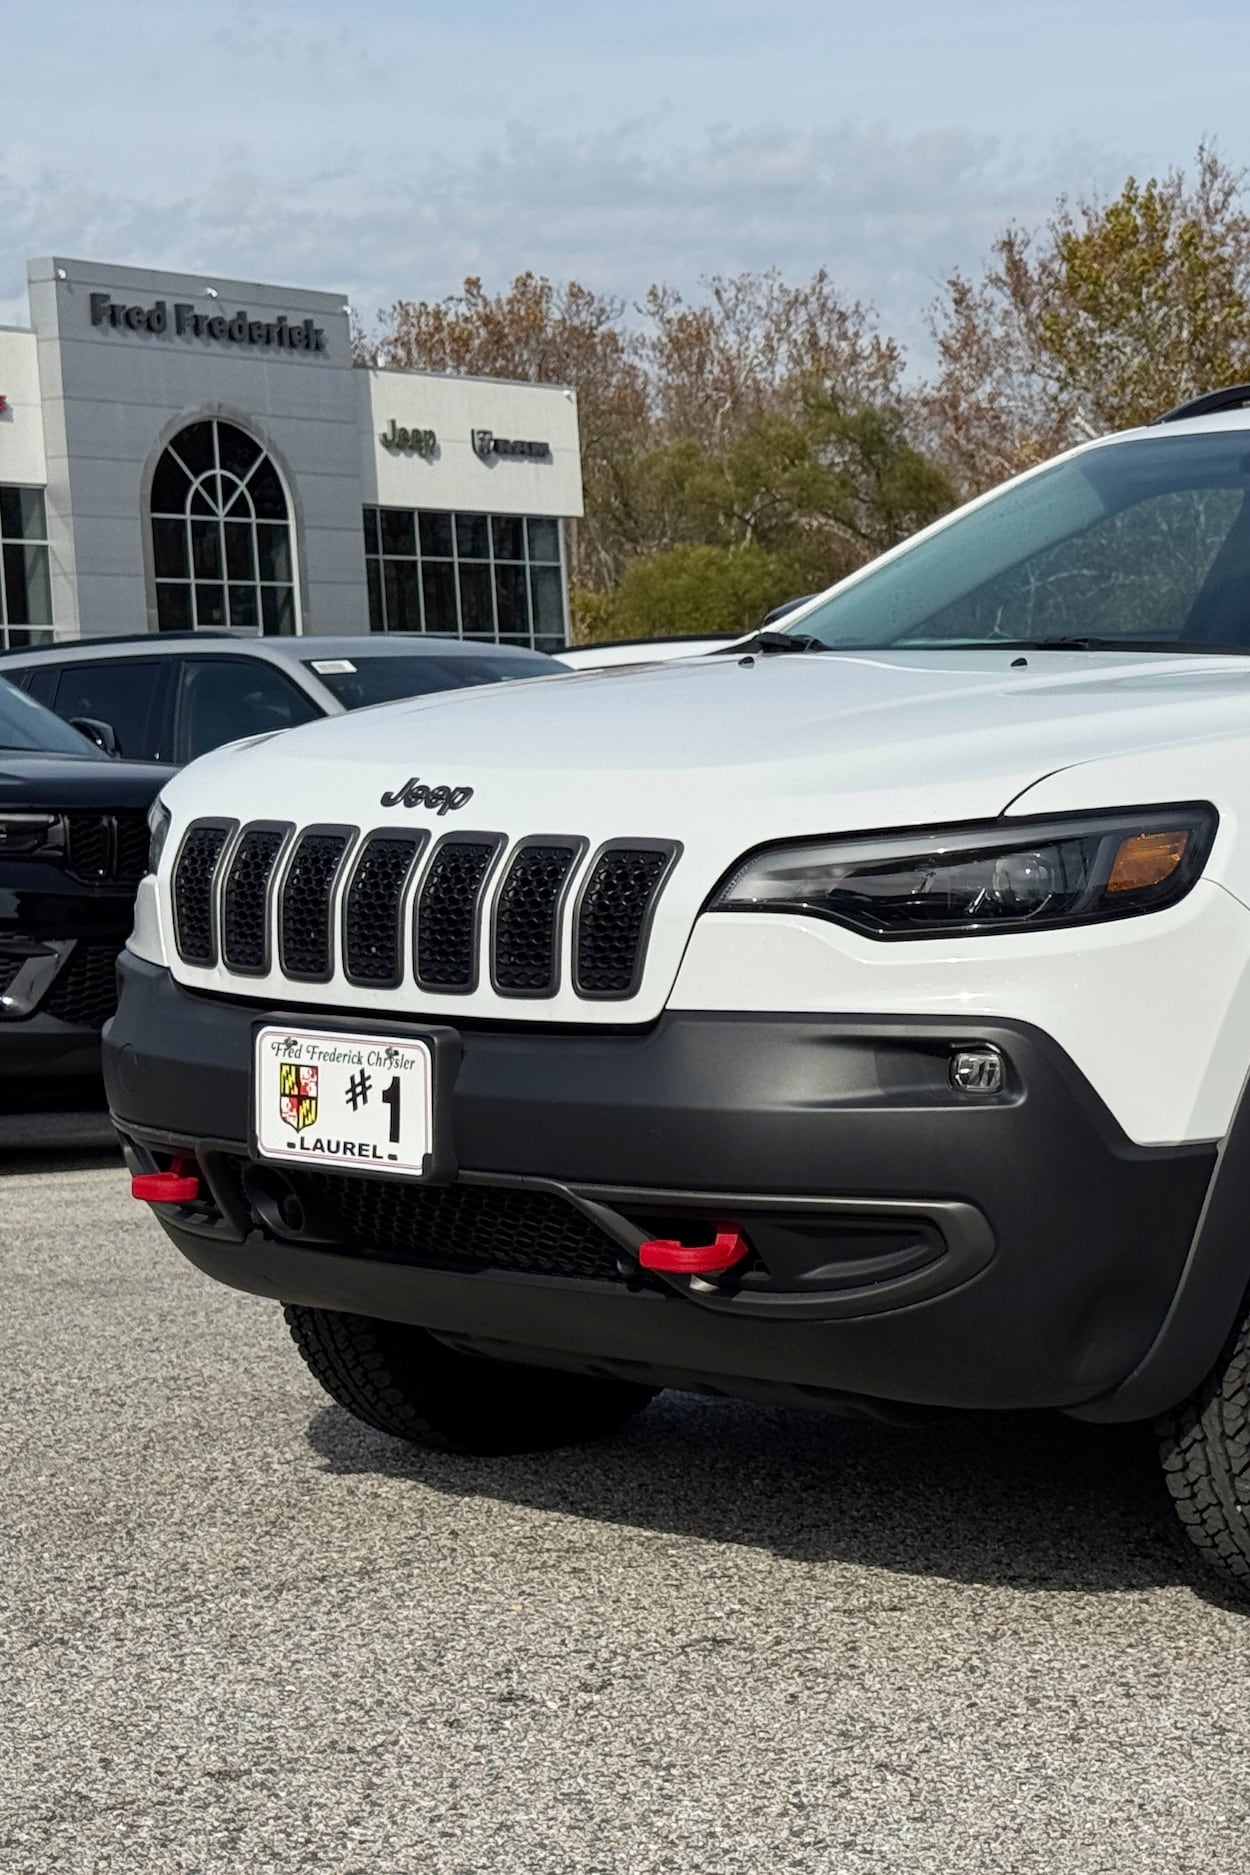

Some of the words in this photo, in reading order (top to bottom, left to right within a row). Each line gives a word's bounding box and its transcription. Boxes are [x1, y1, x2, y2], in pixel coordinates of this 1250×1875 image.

[90, 293, 168, 334] Fred
[174, 303, 327, 351] Frederick
[378, 418, 437, 458] Jeep
[380, 777, 475, 816] Jeep
[271, 1041, 302, 1059] Fred
[306, 1045, 364, 1066] Frederick
[367, 1051, 416, 1071] Chrysler
[300, 1136, 384, 1160] LAUREL
